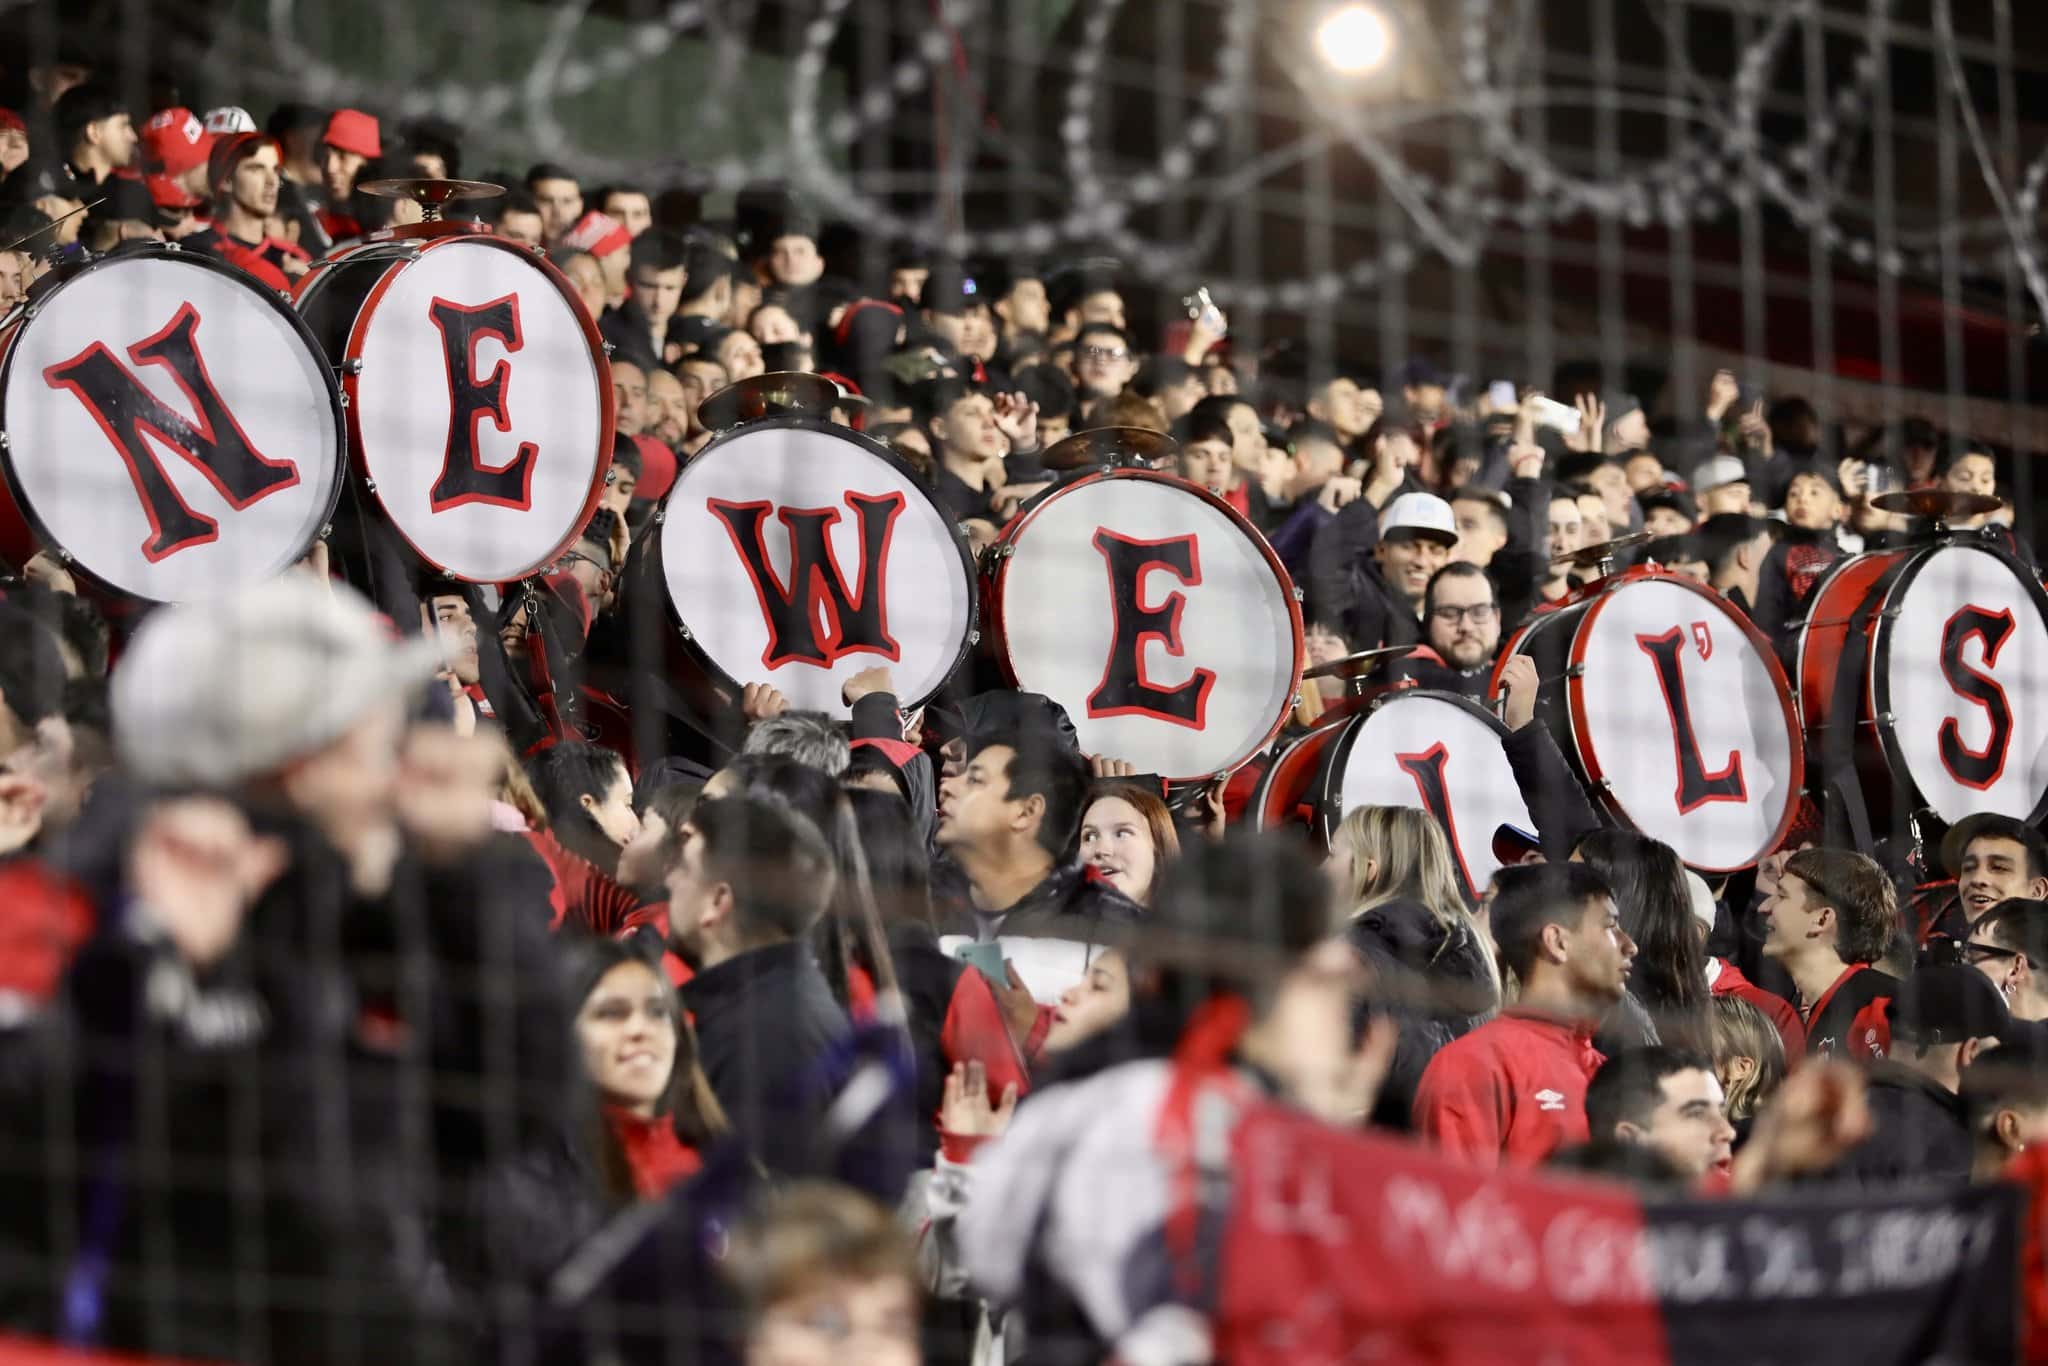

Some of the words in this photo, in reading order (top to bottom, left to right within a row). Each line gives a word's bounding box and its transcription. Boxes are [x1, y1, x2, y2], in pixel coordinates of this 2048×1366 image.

[43, 301, 299, 563] N
[429, 292, 539, 512] E
[707, 490, 906, 670] W
[1087, 526, 1216, 730] E
[1938, 604, 2015, 790] S
